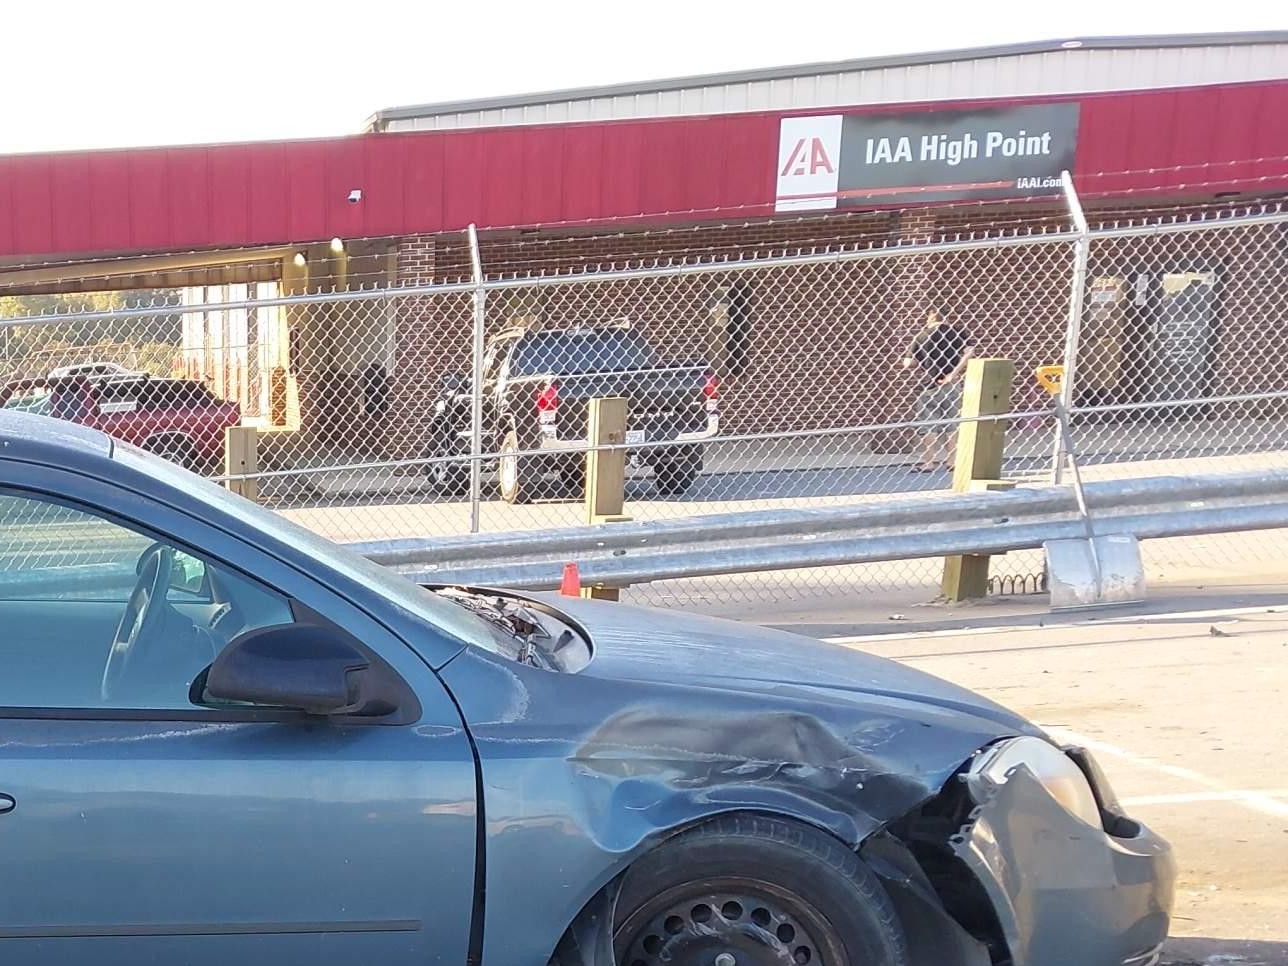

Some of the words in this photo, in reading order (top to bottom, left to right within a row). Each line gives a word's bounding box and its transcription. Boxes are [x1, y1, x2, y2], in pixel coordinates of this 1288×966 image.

[865, 136, 913, 164] IAA
[919, 133, 978, 166] High
[985, 130, 1052, 158] Point
